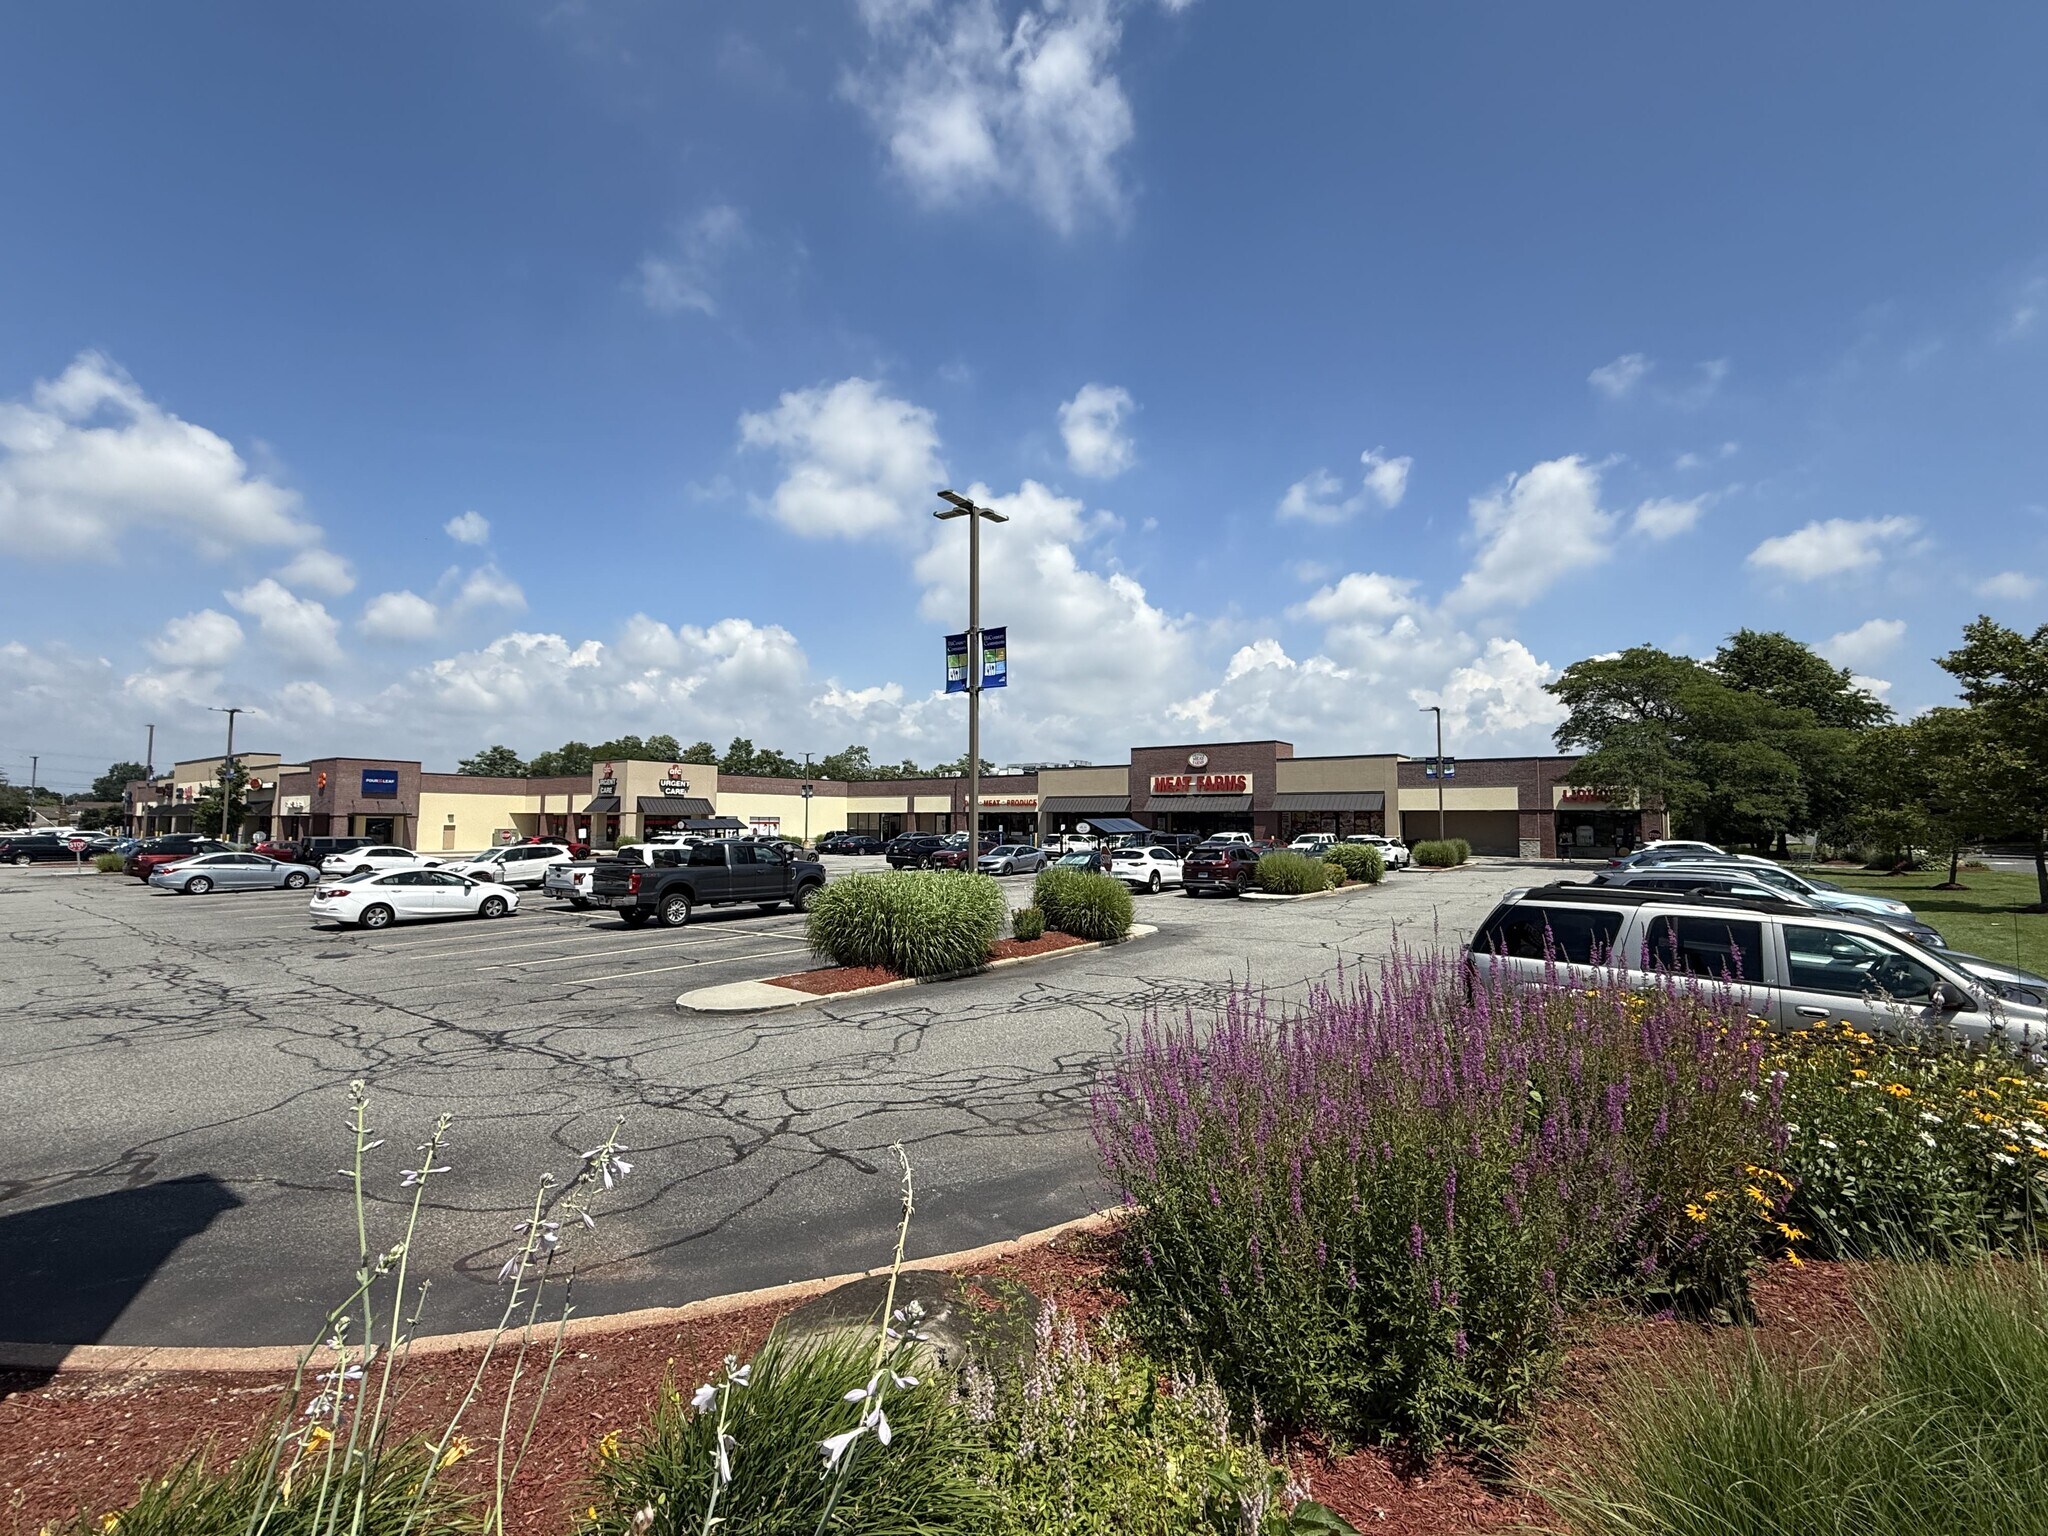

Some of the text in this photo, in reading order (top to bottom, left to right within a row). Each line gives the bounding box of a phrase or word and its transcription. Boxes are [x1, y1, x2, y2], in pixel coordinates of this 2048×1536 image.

[669, 767, 682, 775] afc
[1154, 775, 1247, 792] MEAT FARMS
[1006, 799, 1037, 807] PRODUCE
